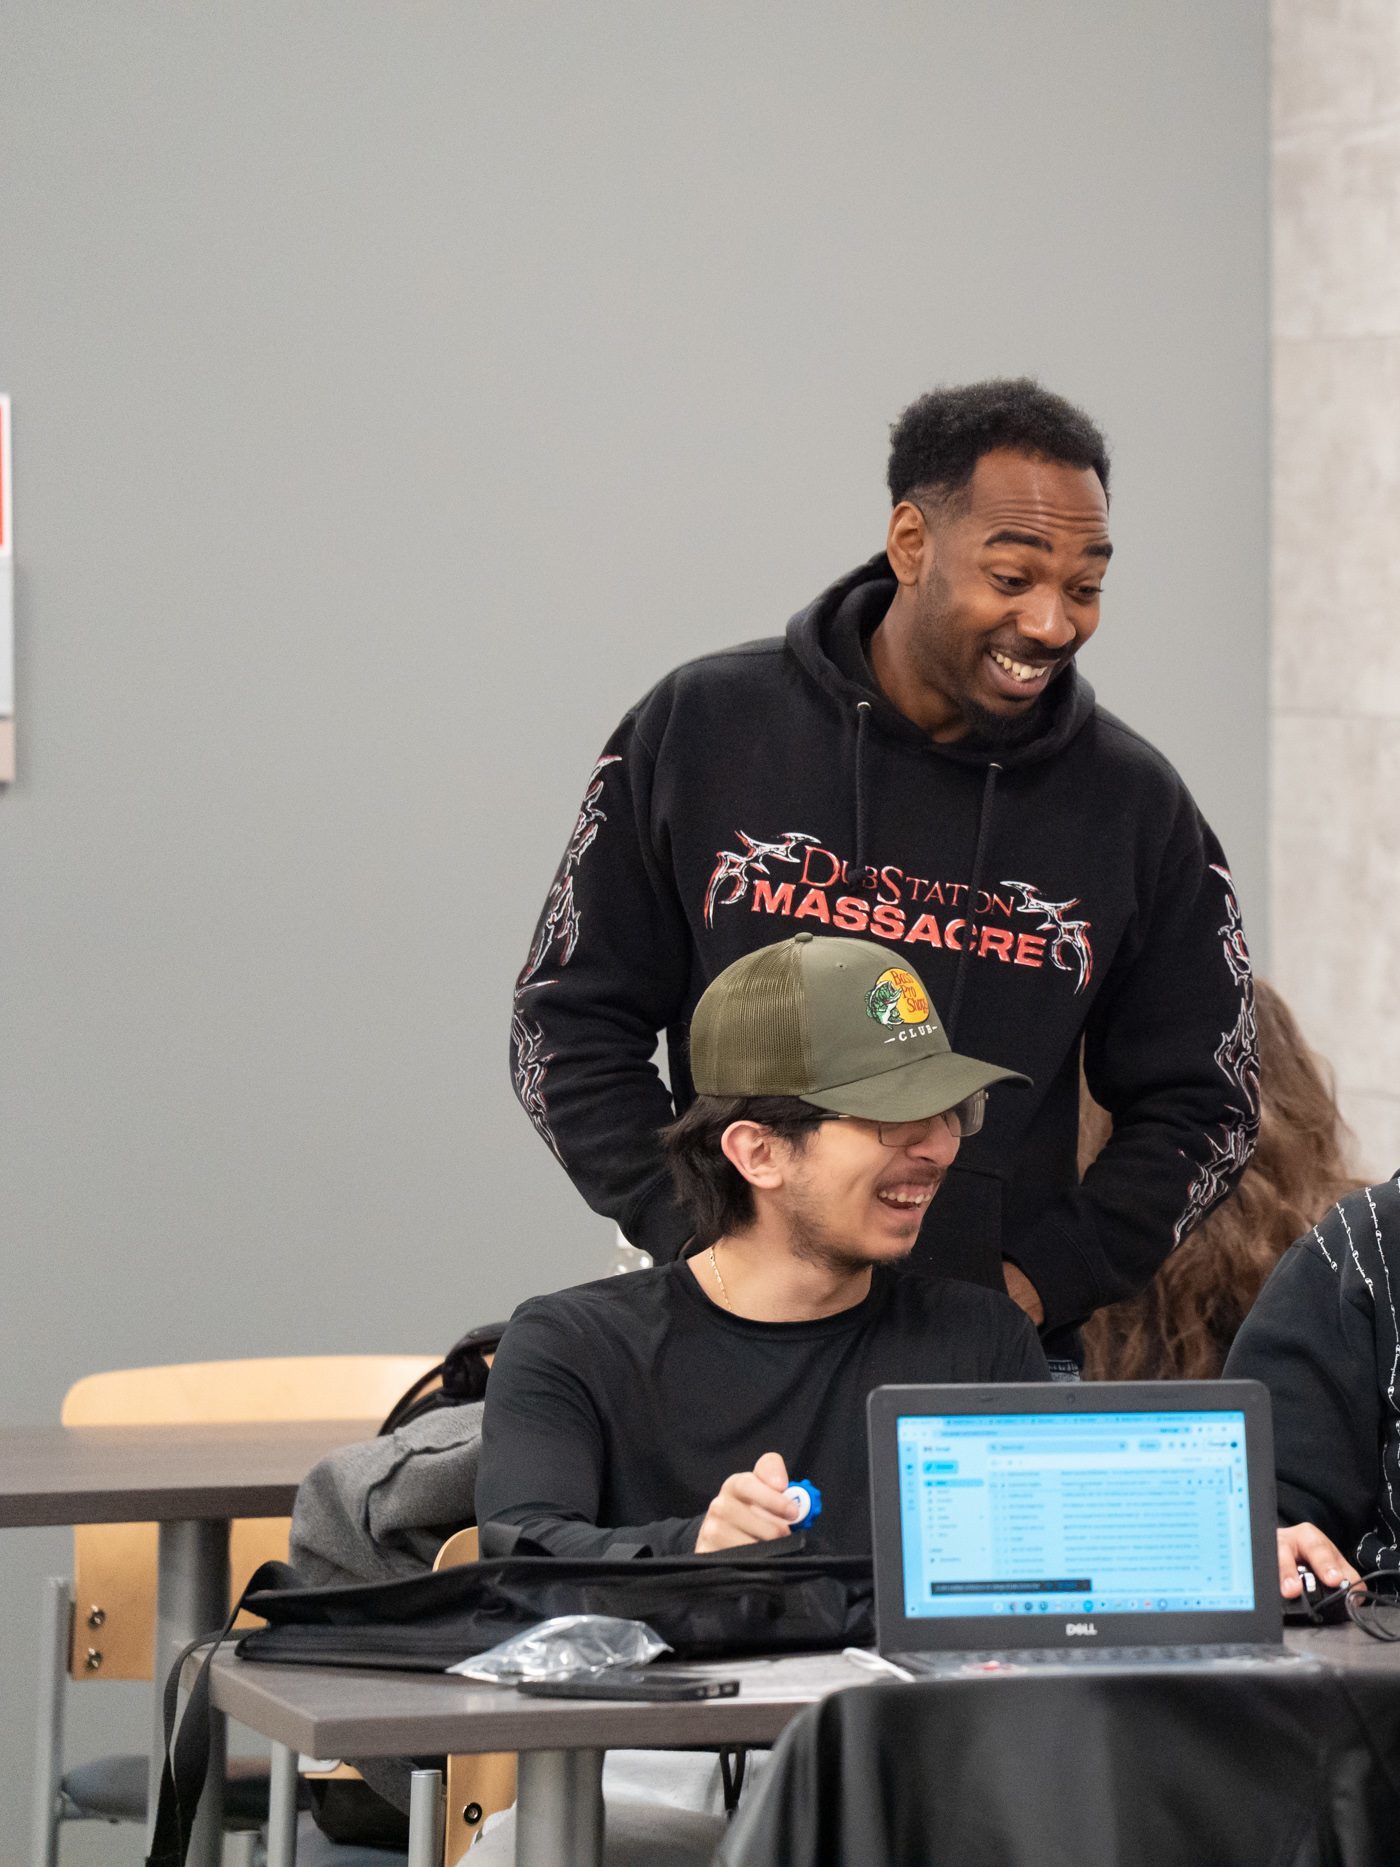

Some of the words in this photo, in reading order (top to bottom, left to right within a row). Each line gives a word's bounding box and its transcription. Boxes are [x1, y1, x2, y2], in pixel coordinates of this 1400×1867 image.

[751, 879, 1048, 968] MASSACRE
[901, 985, 917, 999] Pro
[898, 1024, 934, 1042] CLUB
[1065, 1623, 1098, 1636] DELL
